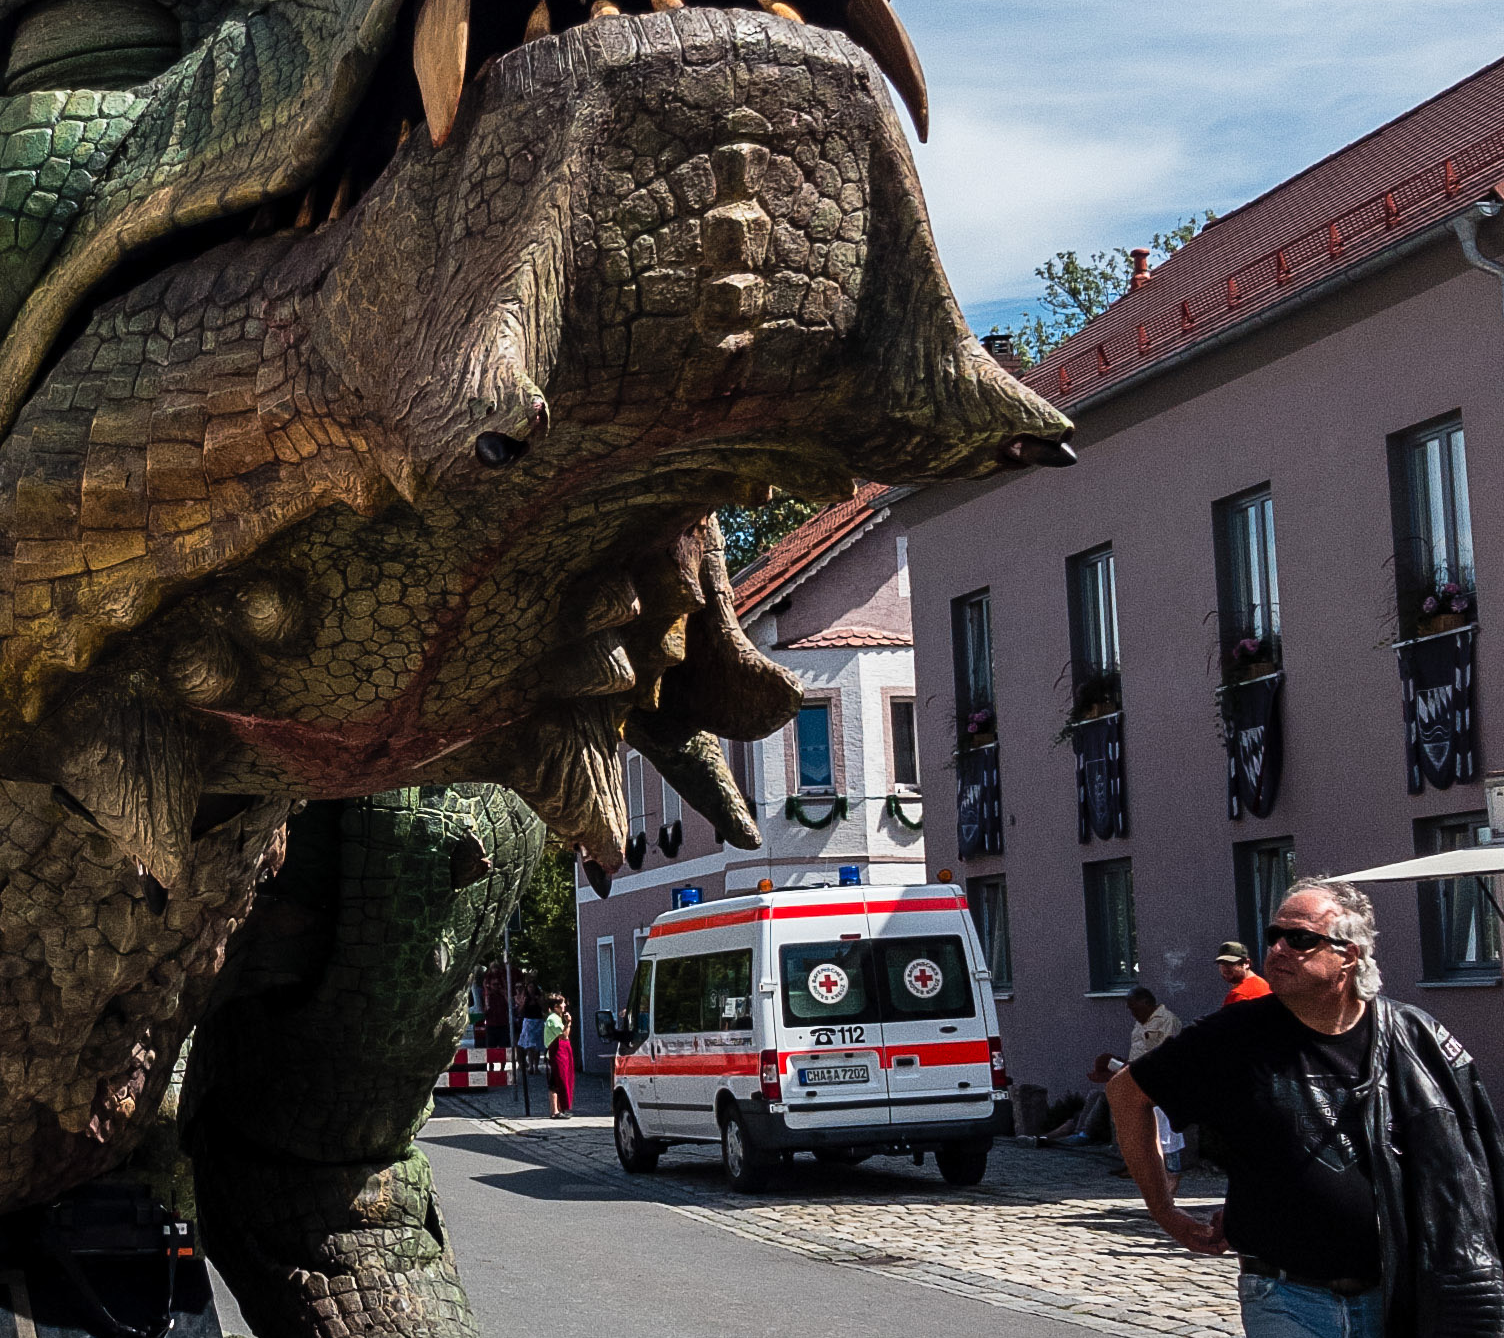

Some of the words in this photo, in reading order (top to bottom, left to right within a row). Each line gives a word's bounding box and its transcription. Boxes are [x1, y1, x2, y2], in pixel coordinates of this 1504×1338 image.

[838, 1026, 865, 1044] 112
[806, 1070, 827, 1082] CHA
[833, 1069, 840, 1081] A
[841, 1068, 867, 1080] 7202
